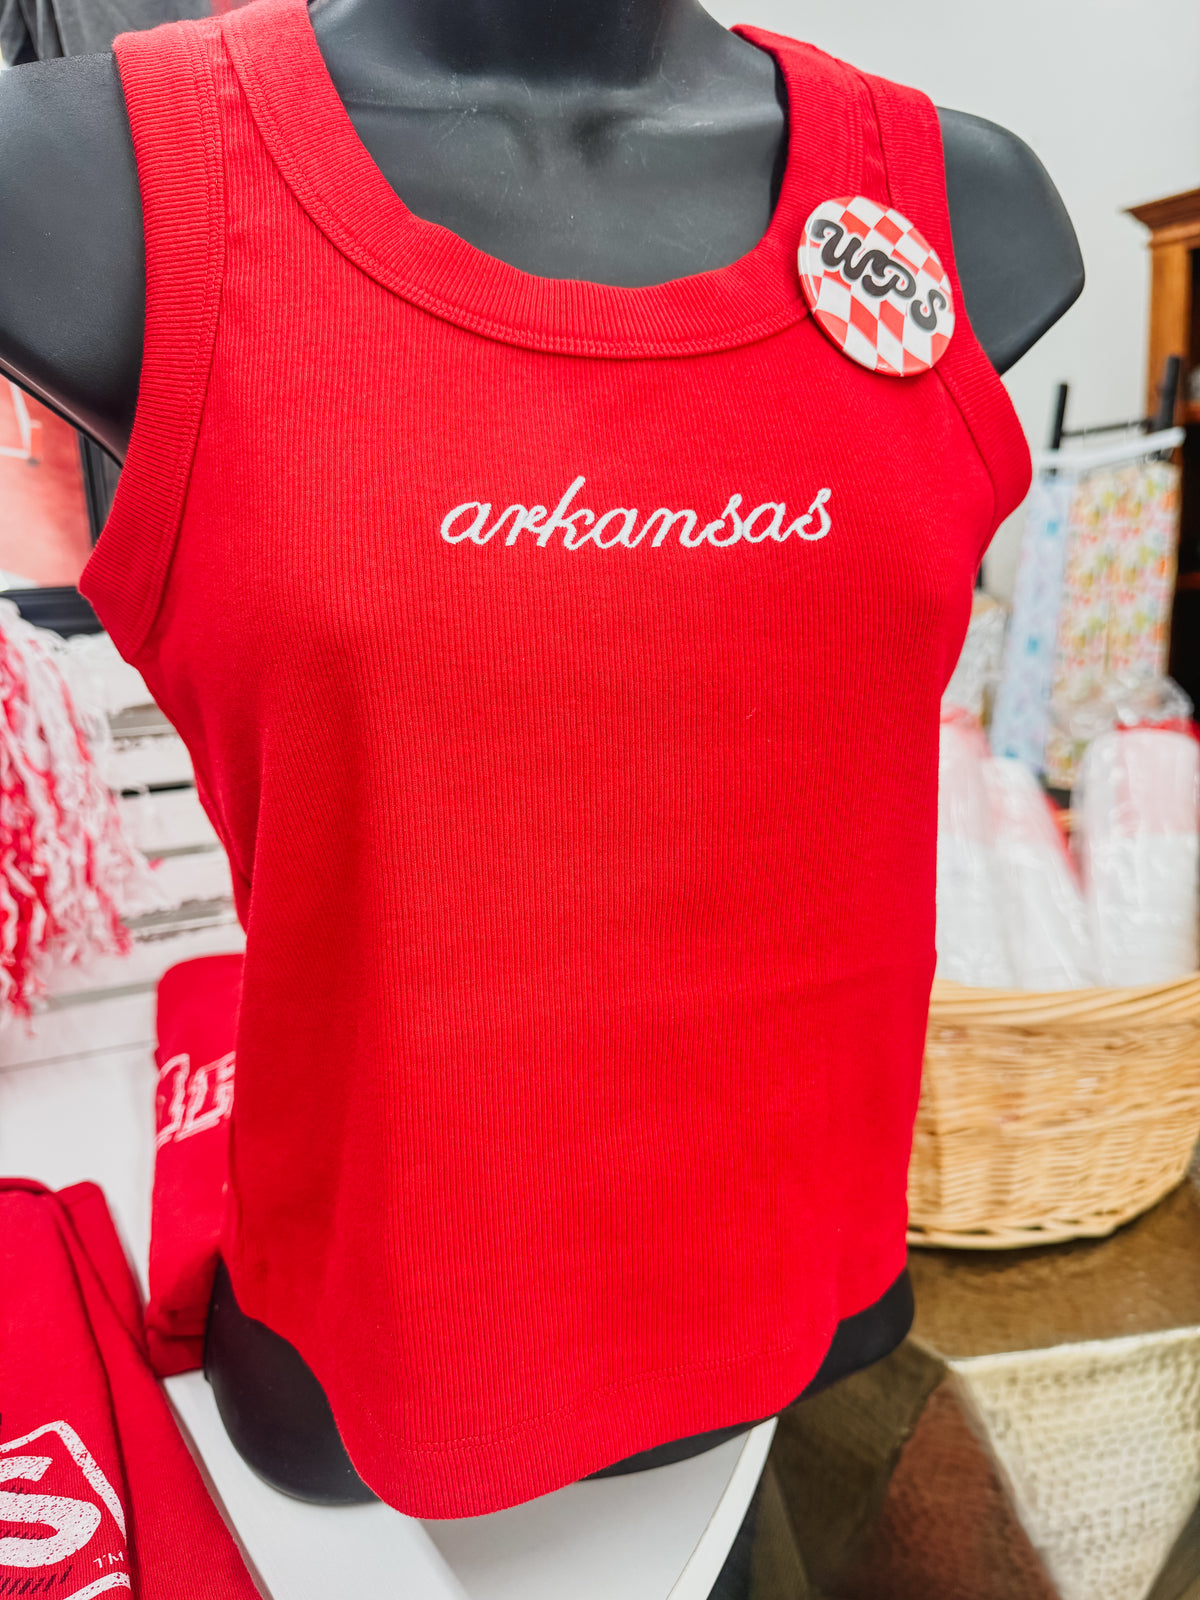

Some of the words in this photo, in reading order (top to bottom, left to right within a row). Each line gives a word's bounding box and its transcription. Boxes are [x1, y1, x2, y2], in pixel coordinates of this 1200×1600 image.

[810, 219, 947, 331] WPS
[440, 475, 832, 550] arkansas
[93, 1551, 124, 1568] TM
